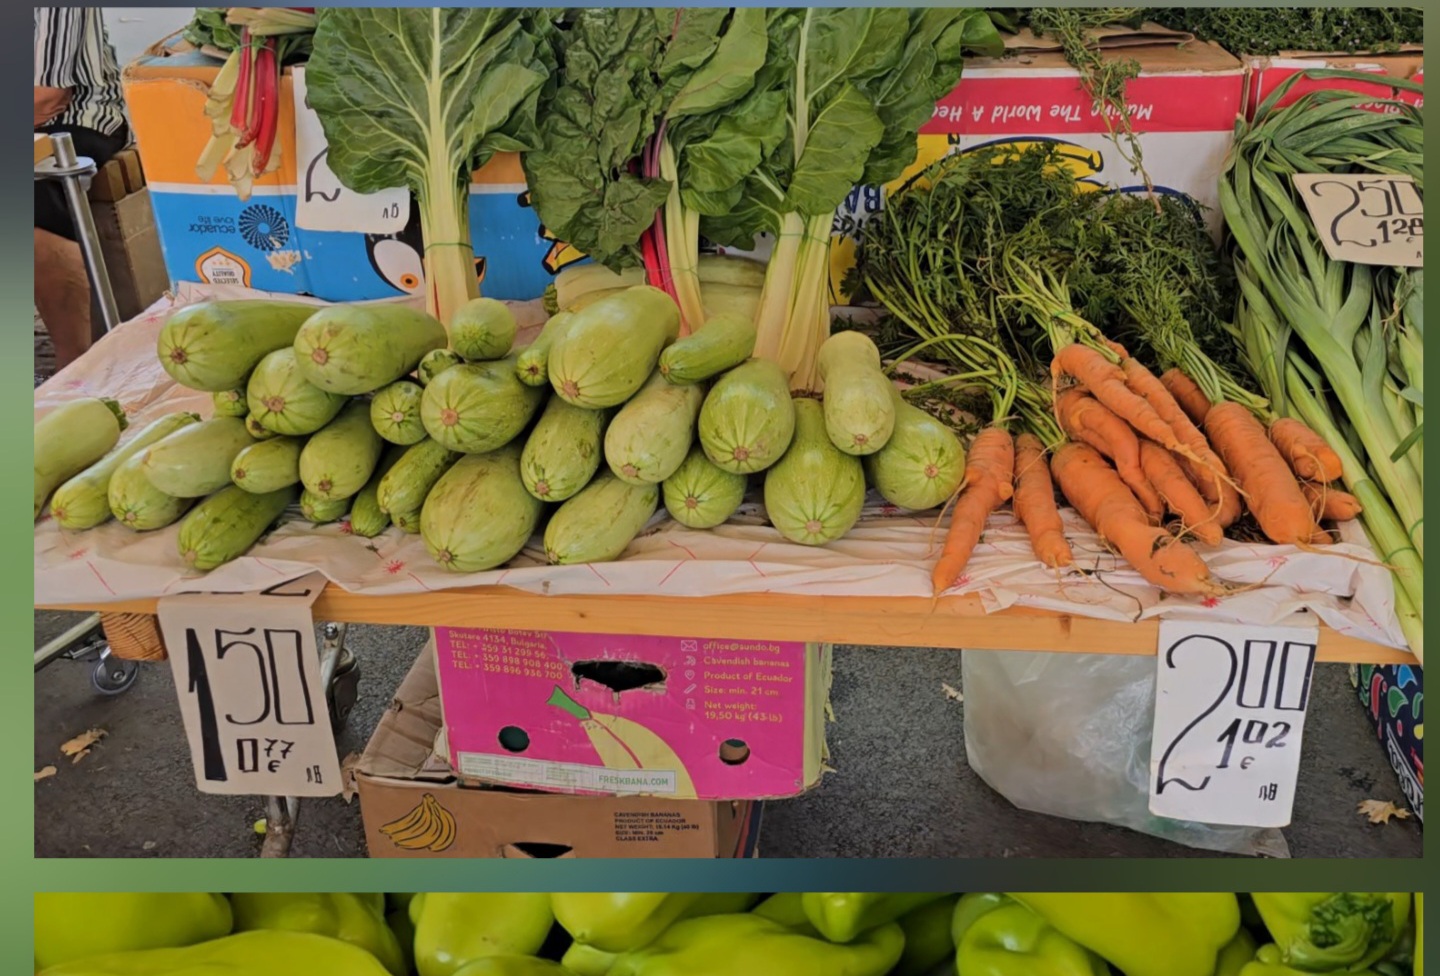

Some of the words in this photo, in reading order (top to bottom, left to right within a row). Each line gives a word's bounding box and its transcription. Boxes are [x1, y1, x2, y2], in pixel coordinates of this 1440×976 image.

[972, 105, 984, 122] A
[991, 104, 1041, 122] World
[1050, 104, 1081, 121] The
[189, 223, 236, 234] ecuador
[448, 630, 480, 640] Skutare
[703, 656, 750, 666] Cavendish
[753, 657, 790, 668] bananas
[704, 671, 740, 680] Product
[743, 672, 752, 680] of
[756, 672, 793, 683] Ecuador
[751, 686, 762, 696] 21
[764, 688, 779, 696] cm
[704, 701, 721, 710] Net
[735, 712, 746, 722] kg
